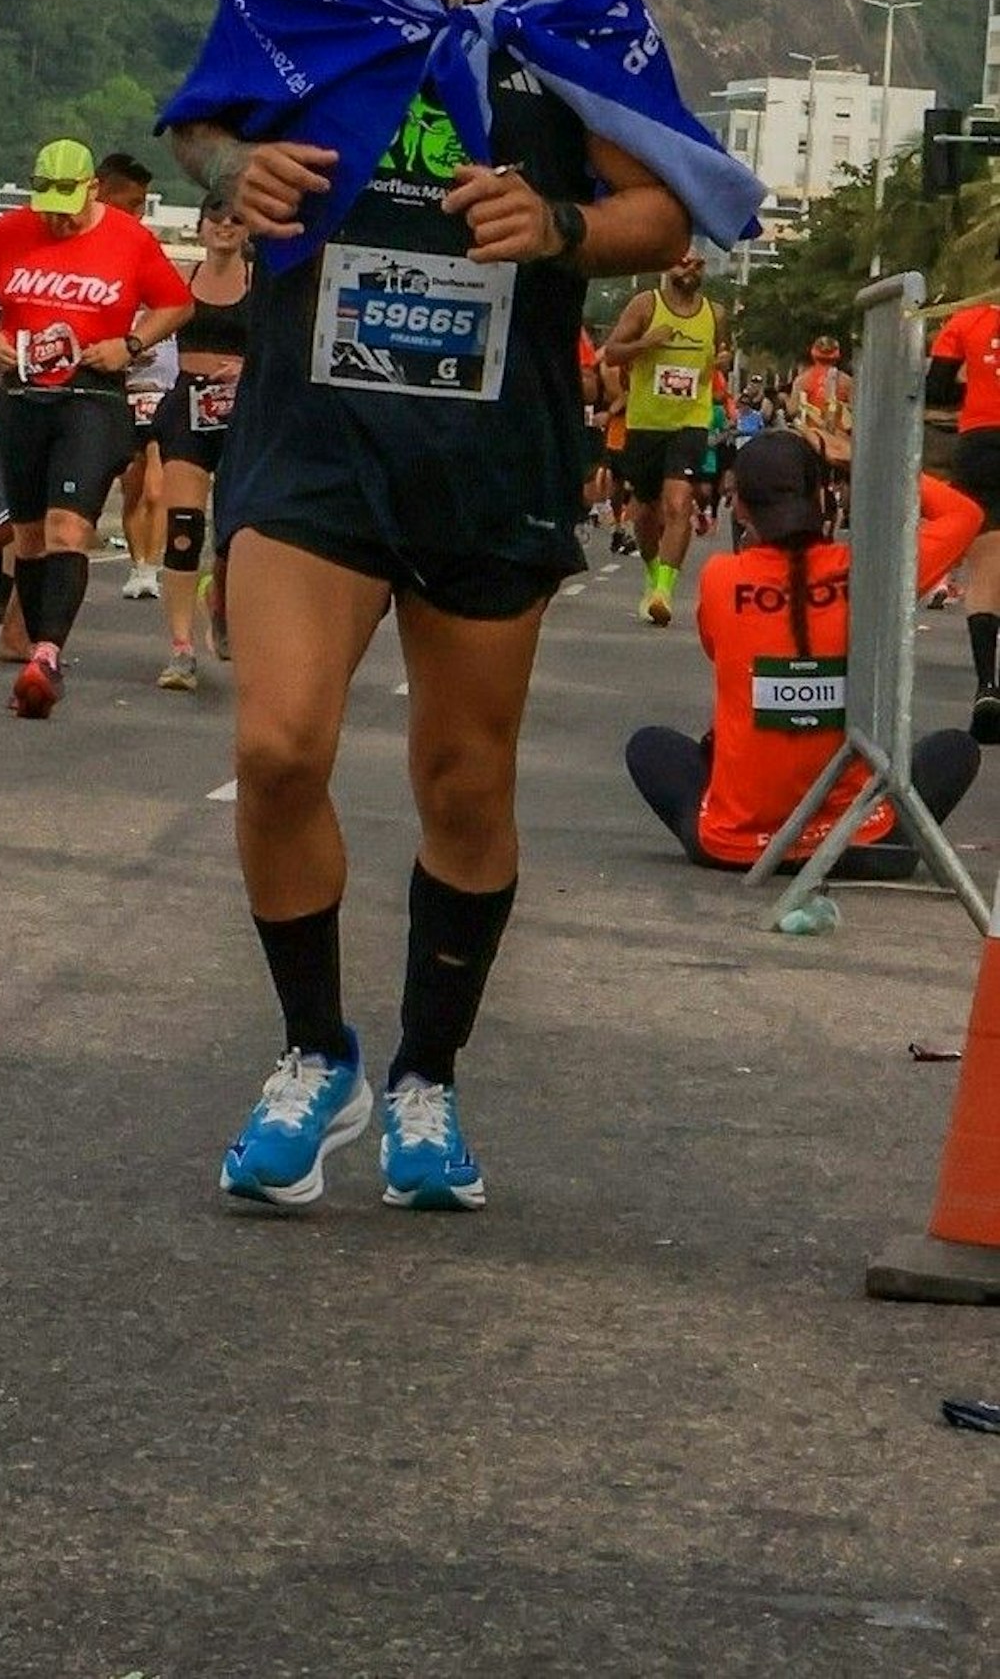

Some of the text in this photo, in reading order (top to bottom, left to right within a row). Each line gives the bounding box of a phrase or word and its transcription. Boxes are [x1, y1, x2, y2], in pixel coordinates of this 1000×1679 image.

[3, 267, 123, 306] INVICTOS
[363, 300, 475, 336] 59665
[773, 685, 835, 702] 100111
